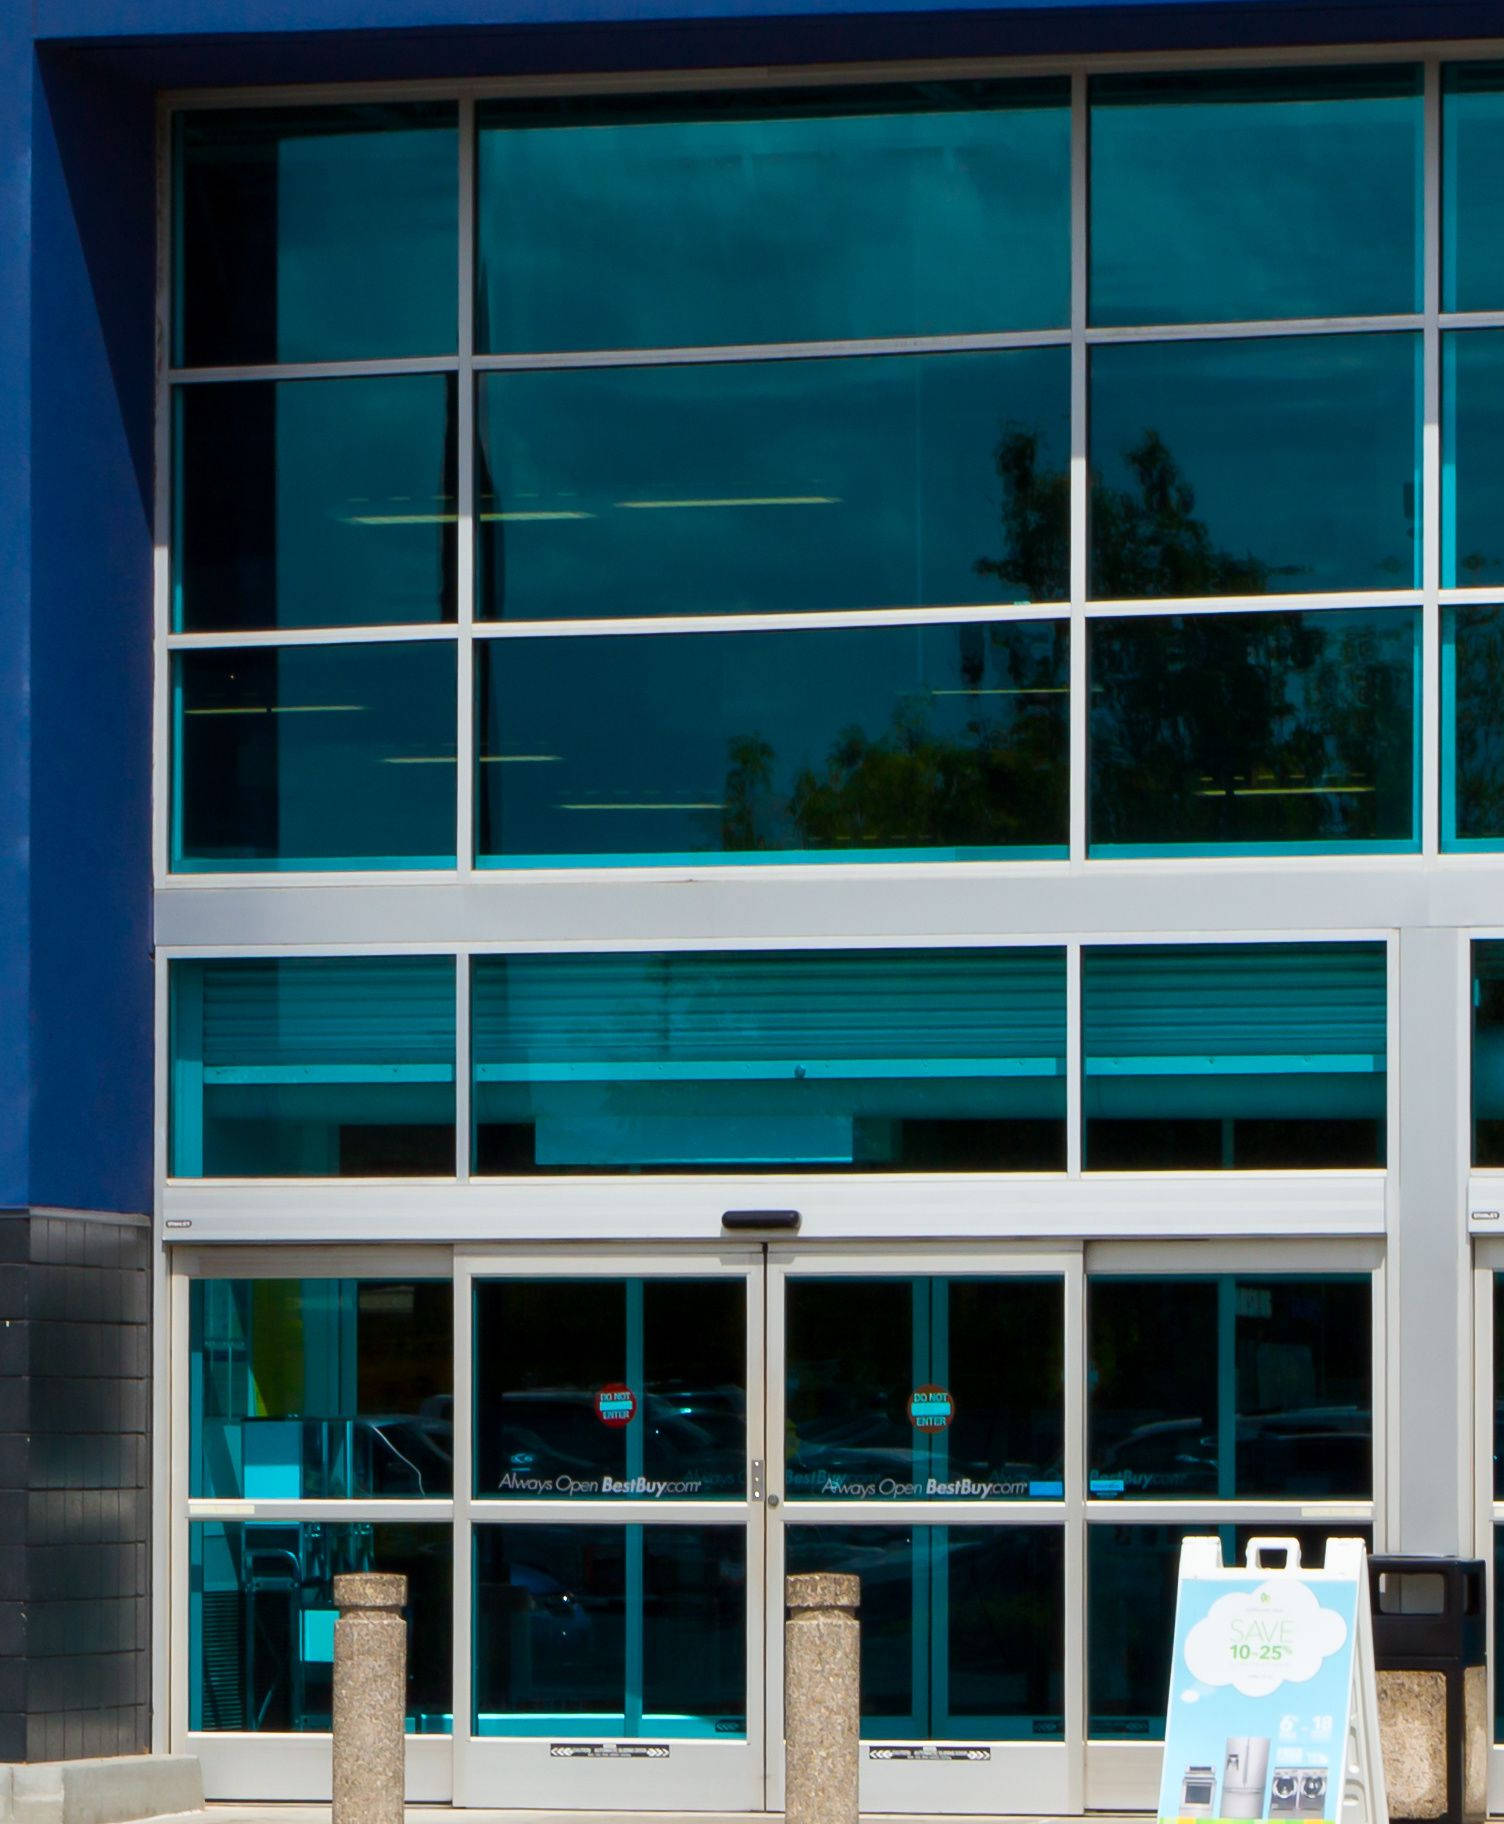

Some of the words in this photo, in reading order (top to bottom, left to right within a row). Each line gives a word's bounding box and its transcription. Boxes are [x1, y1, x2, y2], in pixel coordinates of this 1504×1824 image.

[913, 1392, 927, 1402] DO
[929, 1392, 948, 1402] NOT
[916, 1416, 946, 1426] ENTER
[499, 1473, 553, 1494] Always
[555, 1475, 598, 1496] Open
[601, 1476, 701, 1497] BestBuy.com
[878, 1479, 923, 1500] Open
[925, 1479, 1028, 1499] BestBuy.com
[1230, 1618, 1296, 1643] SAVE
